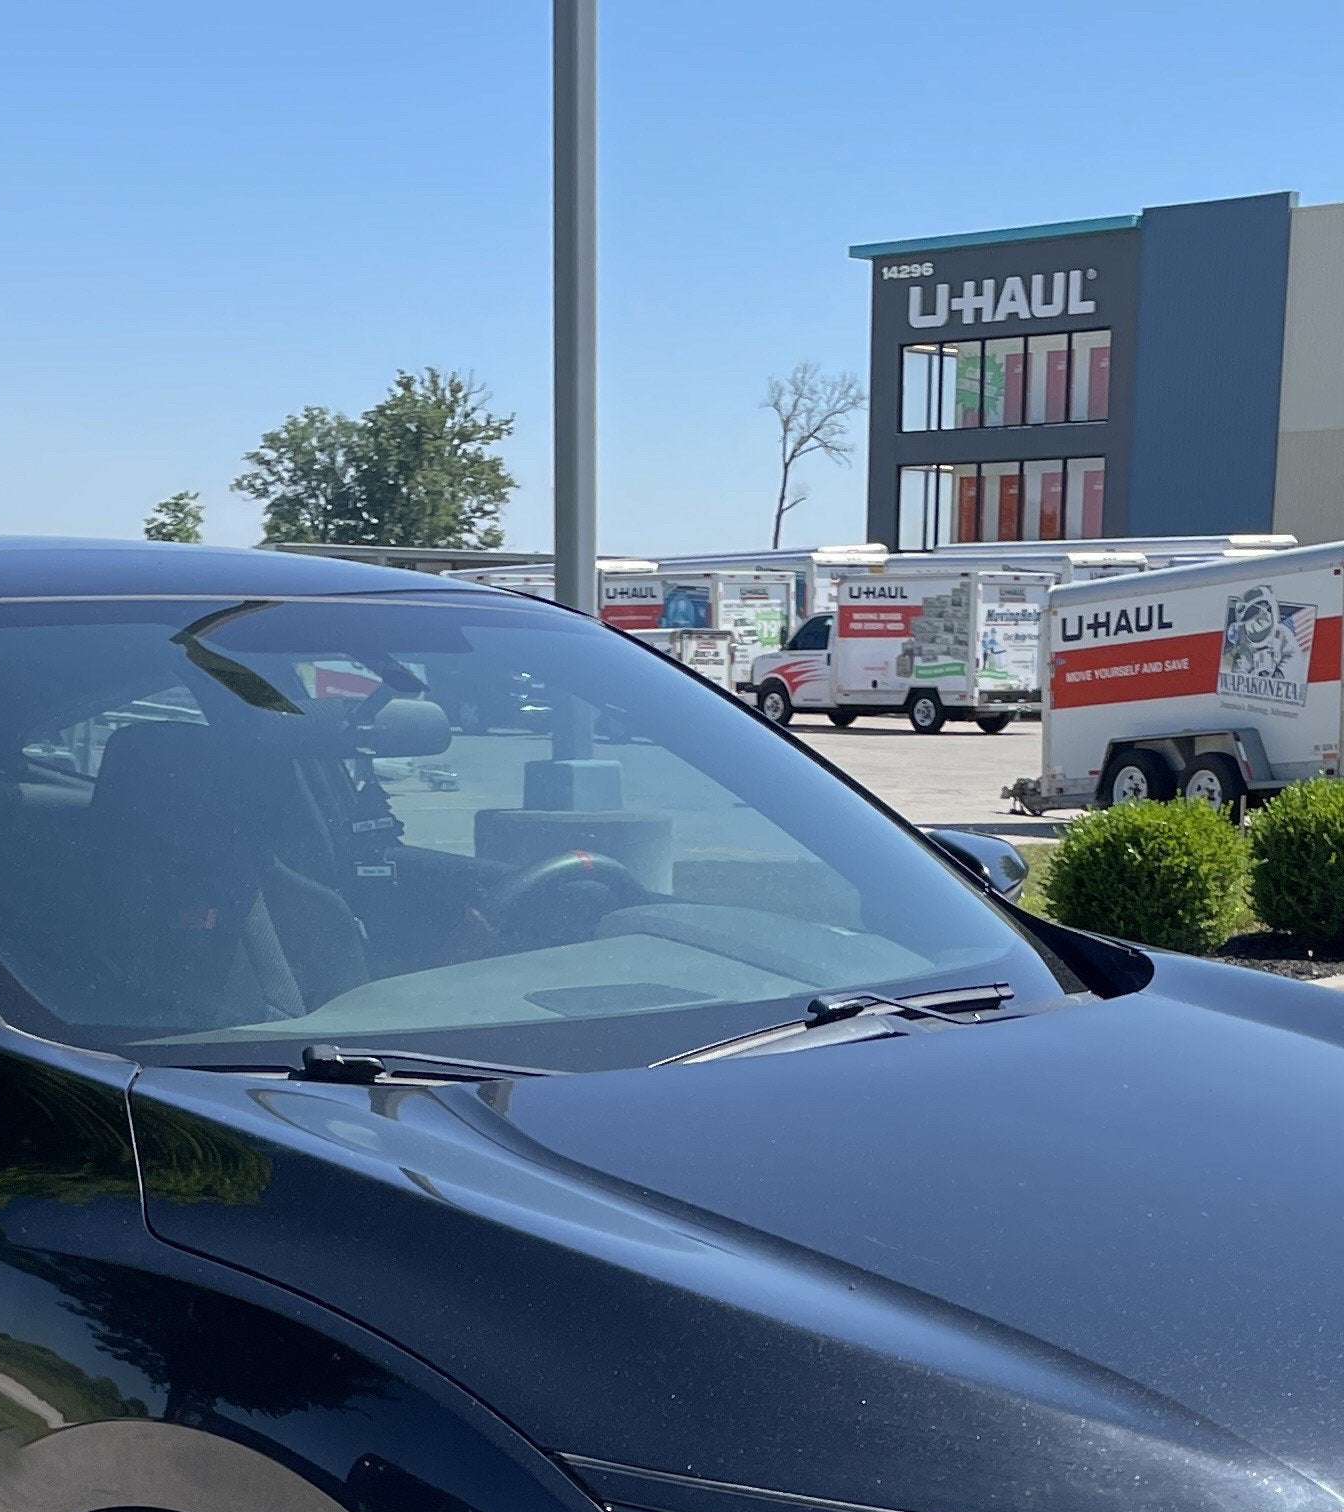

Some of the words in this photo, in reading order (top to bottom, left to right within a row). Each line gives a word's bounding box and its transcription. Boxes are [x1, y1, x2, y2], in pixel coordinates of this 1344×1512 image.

[881, 262, 935, 280] 14296
[908, 269, 1097, 329] U-HAUL
[605, 586, 658, 600] U-HAUL
[848, 586, 908, 600] U-HAUL
[1060, 603, 1175, 643] U-HAUL
[1065, 669, 1093, 684] MOVE
[1093, 663, 1141, 681] YOURSELF
[1141, 661, 1164, 675] AND
[1163, 657, 1190, 672] SAVE
